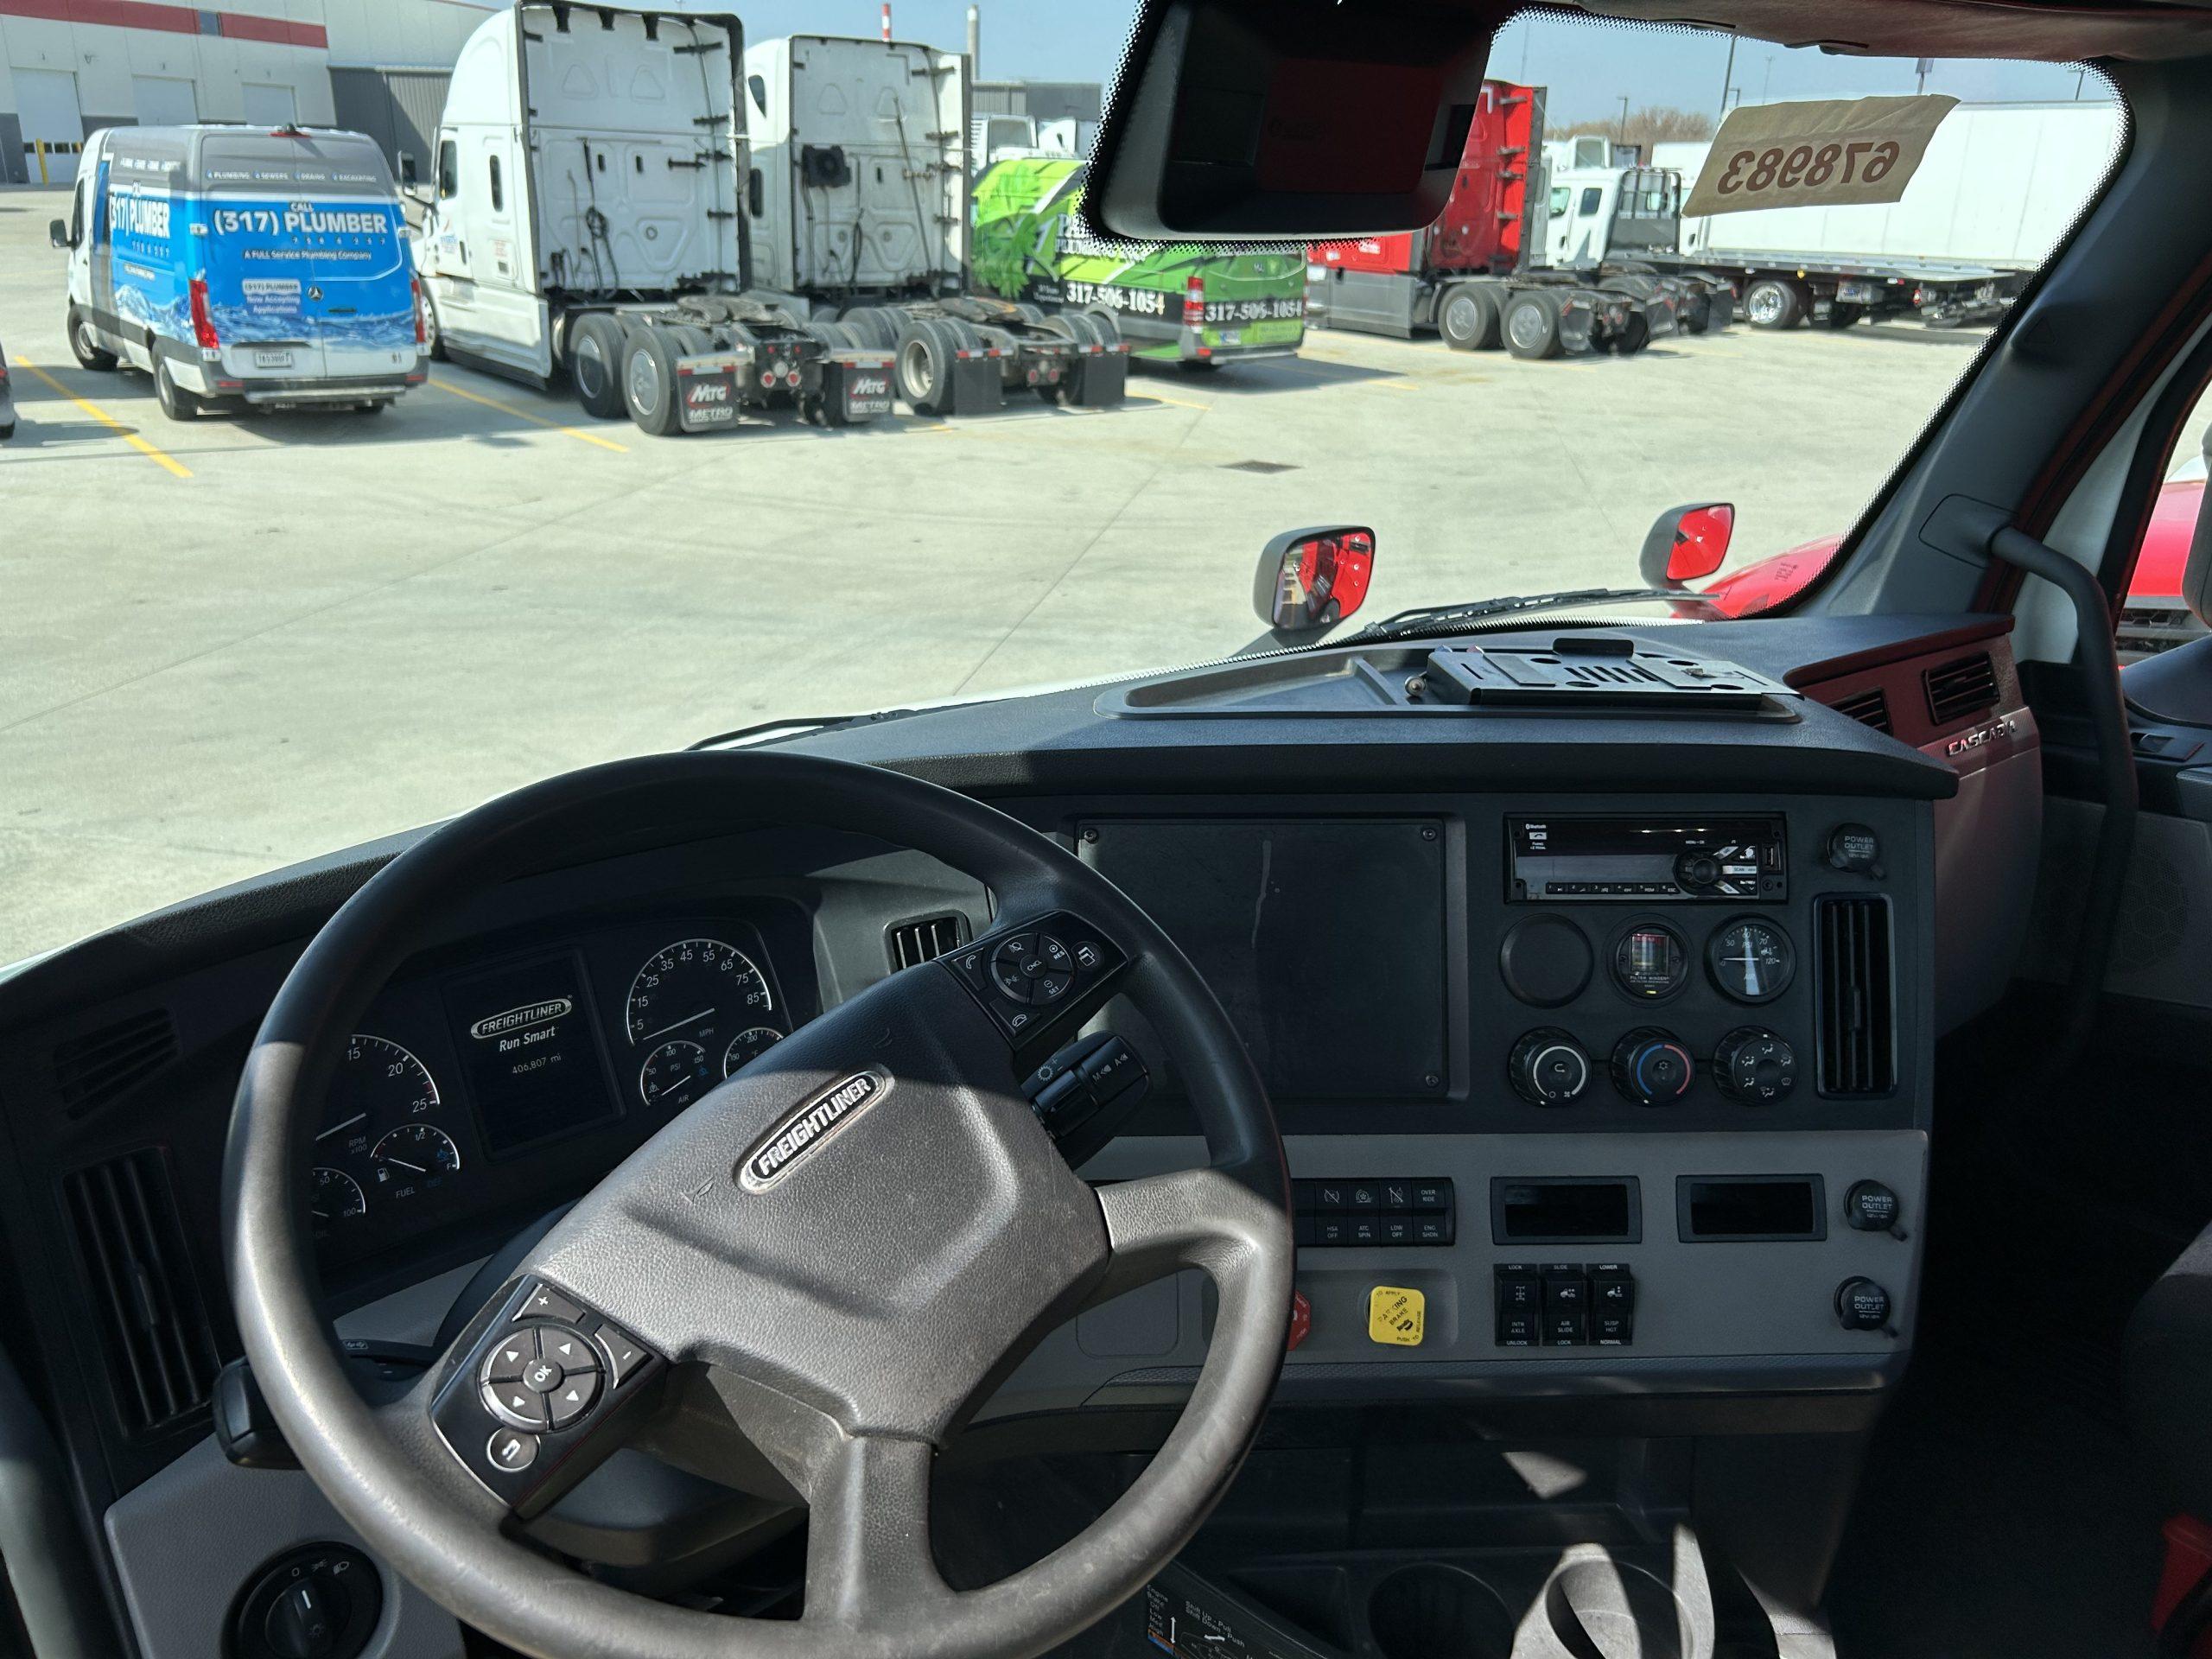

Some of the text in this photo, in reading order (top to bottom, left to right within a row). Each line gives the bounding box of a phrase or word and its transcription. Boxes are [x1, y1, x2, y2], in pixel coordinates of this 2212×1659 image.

[290, 202, 314, 213] CALL
[130, 198, 170, 239] PLUMBER
[214, 209, 388, 236] (317) PLUMBER
[251, 249, 270, 259] FULL
[271, 250, 300, 259] Service
[301, 250, 337, 261] Plumbing
[338, 251, 372, 261] Company
[1066, 281, 1166, 312] 317-506-1054
[690, 406, 734, 419] METRO
[680, 951, 693, 962] 45
[702, 951, 715, 963] 55
[660, 958, 674, 971] 35
[721, 959, 734, 971] 65
[646, 976, 659, 988] 25
[736, 973, 749, 986] 75
[637, 995, 649, 1009] 15
[747, 992, 760, 1005] 85
[481, 1002, 563, 1035] FREIGHTLINER
[499, 1025, 556, 1052] Run Smart
[698, 1027, 715, 1039] MPH
[347, 1047, 361, 1062] 15
[665, 1047, 676, 1058] 100
[388, 1062, 404, 1077] 20
[412, 1098, 428, 1113] 25
[758, 1077, 872, 1176] FREIGHTLINER
[396, 1185, 415, 1199] FUEL
[533, 1364, 554, 1382] OK
